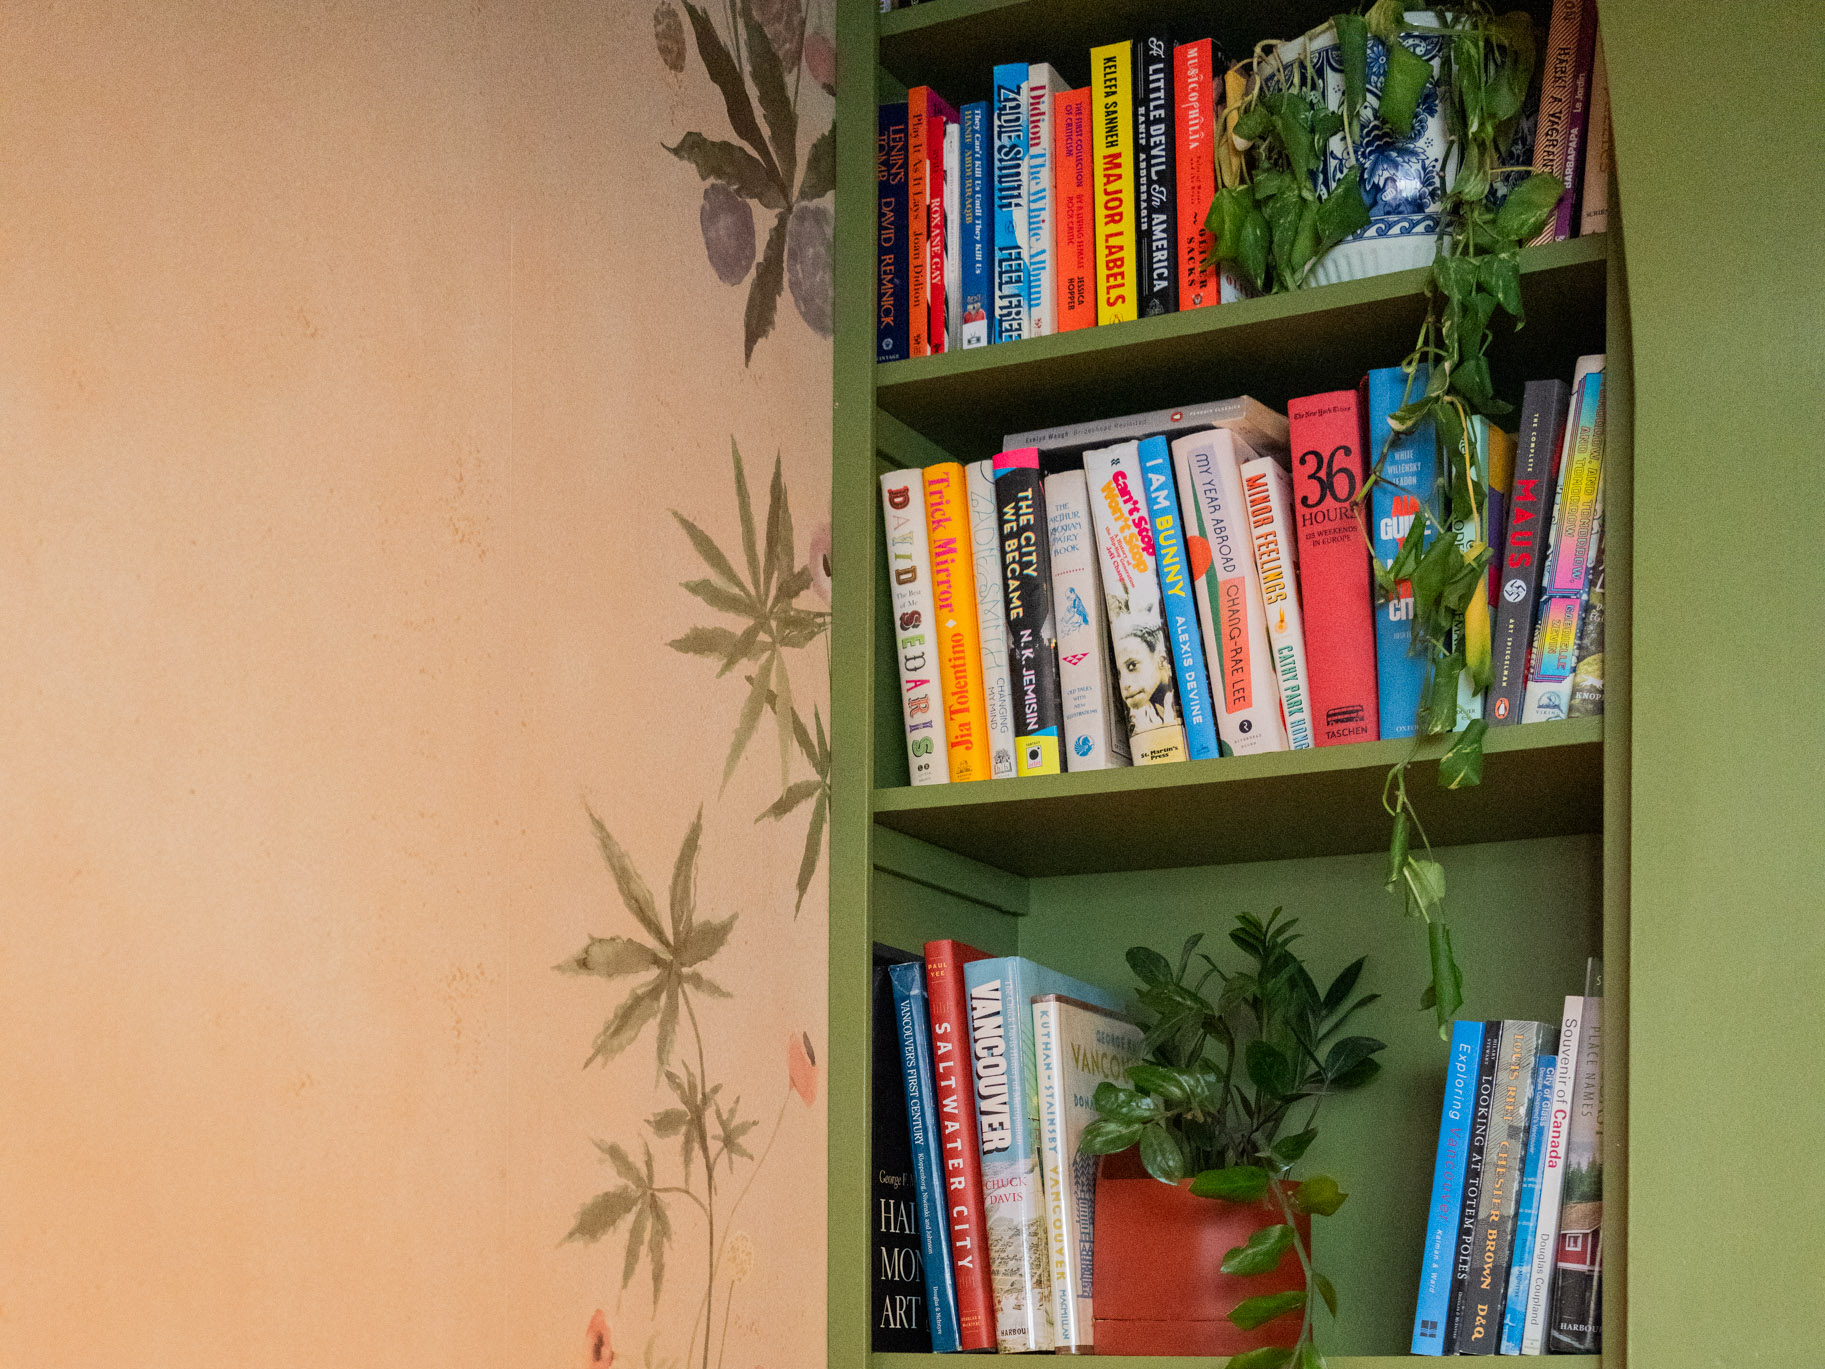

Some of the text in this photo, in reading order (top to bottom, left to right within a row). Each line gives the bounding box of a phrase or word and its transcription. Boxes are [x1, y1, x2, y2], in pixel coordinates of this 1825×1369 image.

[1149, 63, 1165, 120] LITTLE
[889, 125, 905, 184] LENIN'S
[910, 113, 923, 139] Play
[1150, 123, 1166, 180] DEVIL
[963, 150, 974, 224] ABDURRAQIB
[972, 110, 983, 274] They Can't Kill Us Until They Kill Us
[1028, 85, 1047, 308] Didion The White Album
[1103, 56, 1126, 308] KELEFA SANNEH MAJOR LABELS
[1138, 106, 1148, 230] HANIF ABDURRAQIB
[910, 192, 923, 220] Lays
[997, 86, 1024, 342] ZADIE SMITH FEEL FREE
[880, 198, 895, 328] DAVID REMNICK
[912, 231, 923, 257] Joan
[930, 197, 942, 285] ROXANE GAY
[1152, 214, 1169, 292] AMERICA
[1187, 236, 1196, 287] SACKS
[912, 263, 923, 307] Didion
[1299, 445, 1357, 509] 36
[1527, 432, 1538, 472] COMPLETE
[1564, 426, 1591, 538] AND TOMORROW
[1018, 487, 1036, 527] THE
[1101, 480, 1149, 573] Won't Stop
[1112, 470, 1156, 557] Can't Stop
[1302, 505, 1358, 527] HOURS
[1508, 480, 1540, 568] MAUS
[1003, 502, 1024, 621] WE BECAME
[1020, 531, 1039, 577] CITY
[1106, 546, 1128, 583] Jeff Chang
[1195, 453, 1246, 707] MY YEAR ABROAD CHANG-RAE LEE
[888, 486, 934, 758] DAVID SEDARIS
[927, 472, 974, 751] Trick Mirror Jia Tolentino
[970, 488, 1010, 734] ZADIE SMITH CHANGING
[1146, 458, 1203, 726] I AM BUNNY ALEXIS DEVINE
[1246, 473, 1310, 750] MINOR FEELINGS CATHY PARK HONG
[1020, 629, 1033, 647] N.
[1507, 619, 1516, 632] ART
[1022, 648, 1035, 665] K.
[1501, 638, 1514, 688] SPIEGELMAN
[988, 686, 999, 731] MY MIND
[1022, 667, 1040, 732] JEMISIN
[1150, 753, 1169, 761] Press
[1324, 726, 1369, 740] TASCHEN
[928, 962, 947, 970] PAUL
[971, 979, 1011, 1155] VANCOUVER
[1040, 1010, 1054, 1070] KUTHAN
[1484, 1039, 1492, 1065] STEWART
[1490, 1039, 1498, 1061] HILARY
[1587, 1026, 1602, 1066] PLACE
[900, 999, 925, 1146] VANCOUVER'S FIRST CENTURY
[1448, 1043, 1471, 1119] Exploring
[1540, 1067, 1556, 1127] City of Glass
[1582, 1073, 1597, 1118] NAMES
[936, 1022, 973, 1269] SALTWATER CITY
[1044, 1084, 1059, 1152] STAINSBY
[984, 1177, 1027, 1192] CHUCK
[989, 1192, 1024, 1205] DAVIS
[1439, 1128, 1462, 1221] Vancouver
[1457, 1076, 1492, 1280] LOOKING AT TOTEM POLES
[1471, 1034, 1524, 1342] LOUIS RIEL CHESTER BROWN D&Q
[1531, 1018, 1578, 1326] Souvenir of Canada Douglas Coupland
[925, 1219, 933, 1229] and
[925, 1229, 935, 1255] Johnson
[1049, 1165, 1066, 1280] VANCOUVER
[1433, 1229, 1444, 1260] Kalman
[880, 1295, 921, 1328] ART
[1429, 1273, 1438, 1294] Ward
[1059, 1289, 1070, 1340] MACMILLAN
